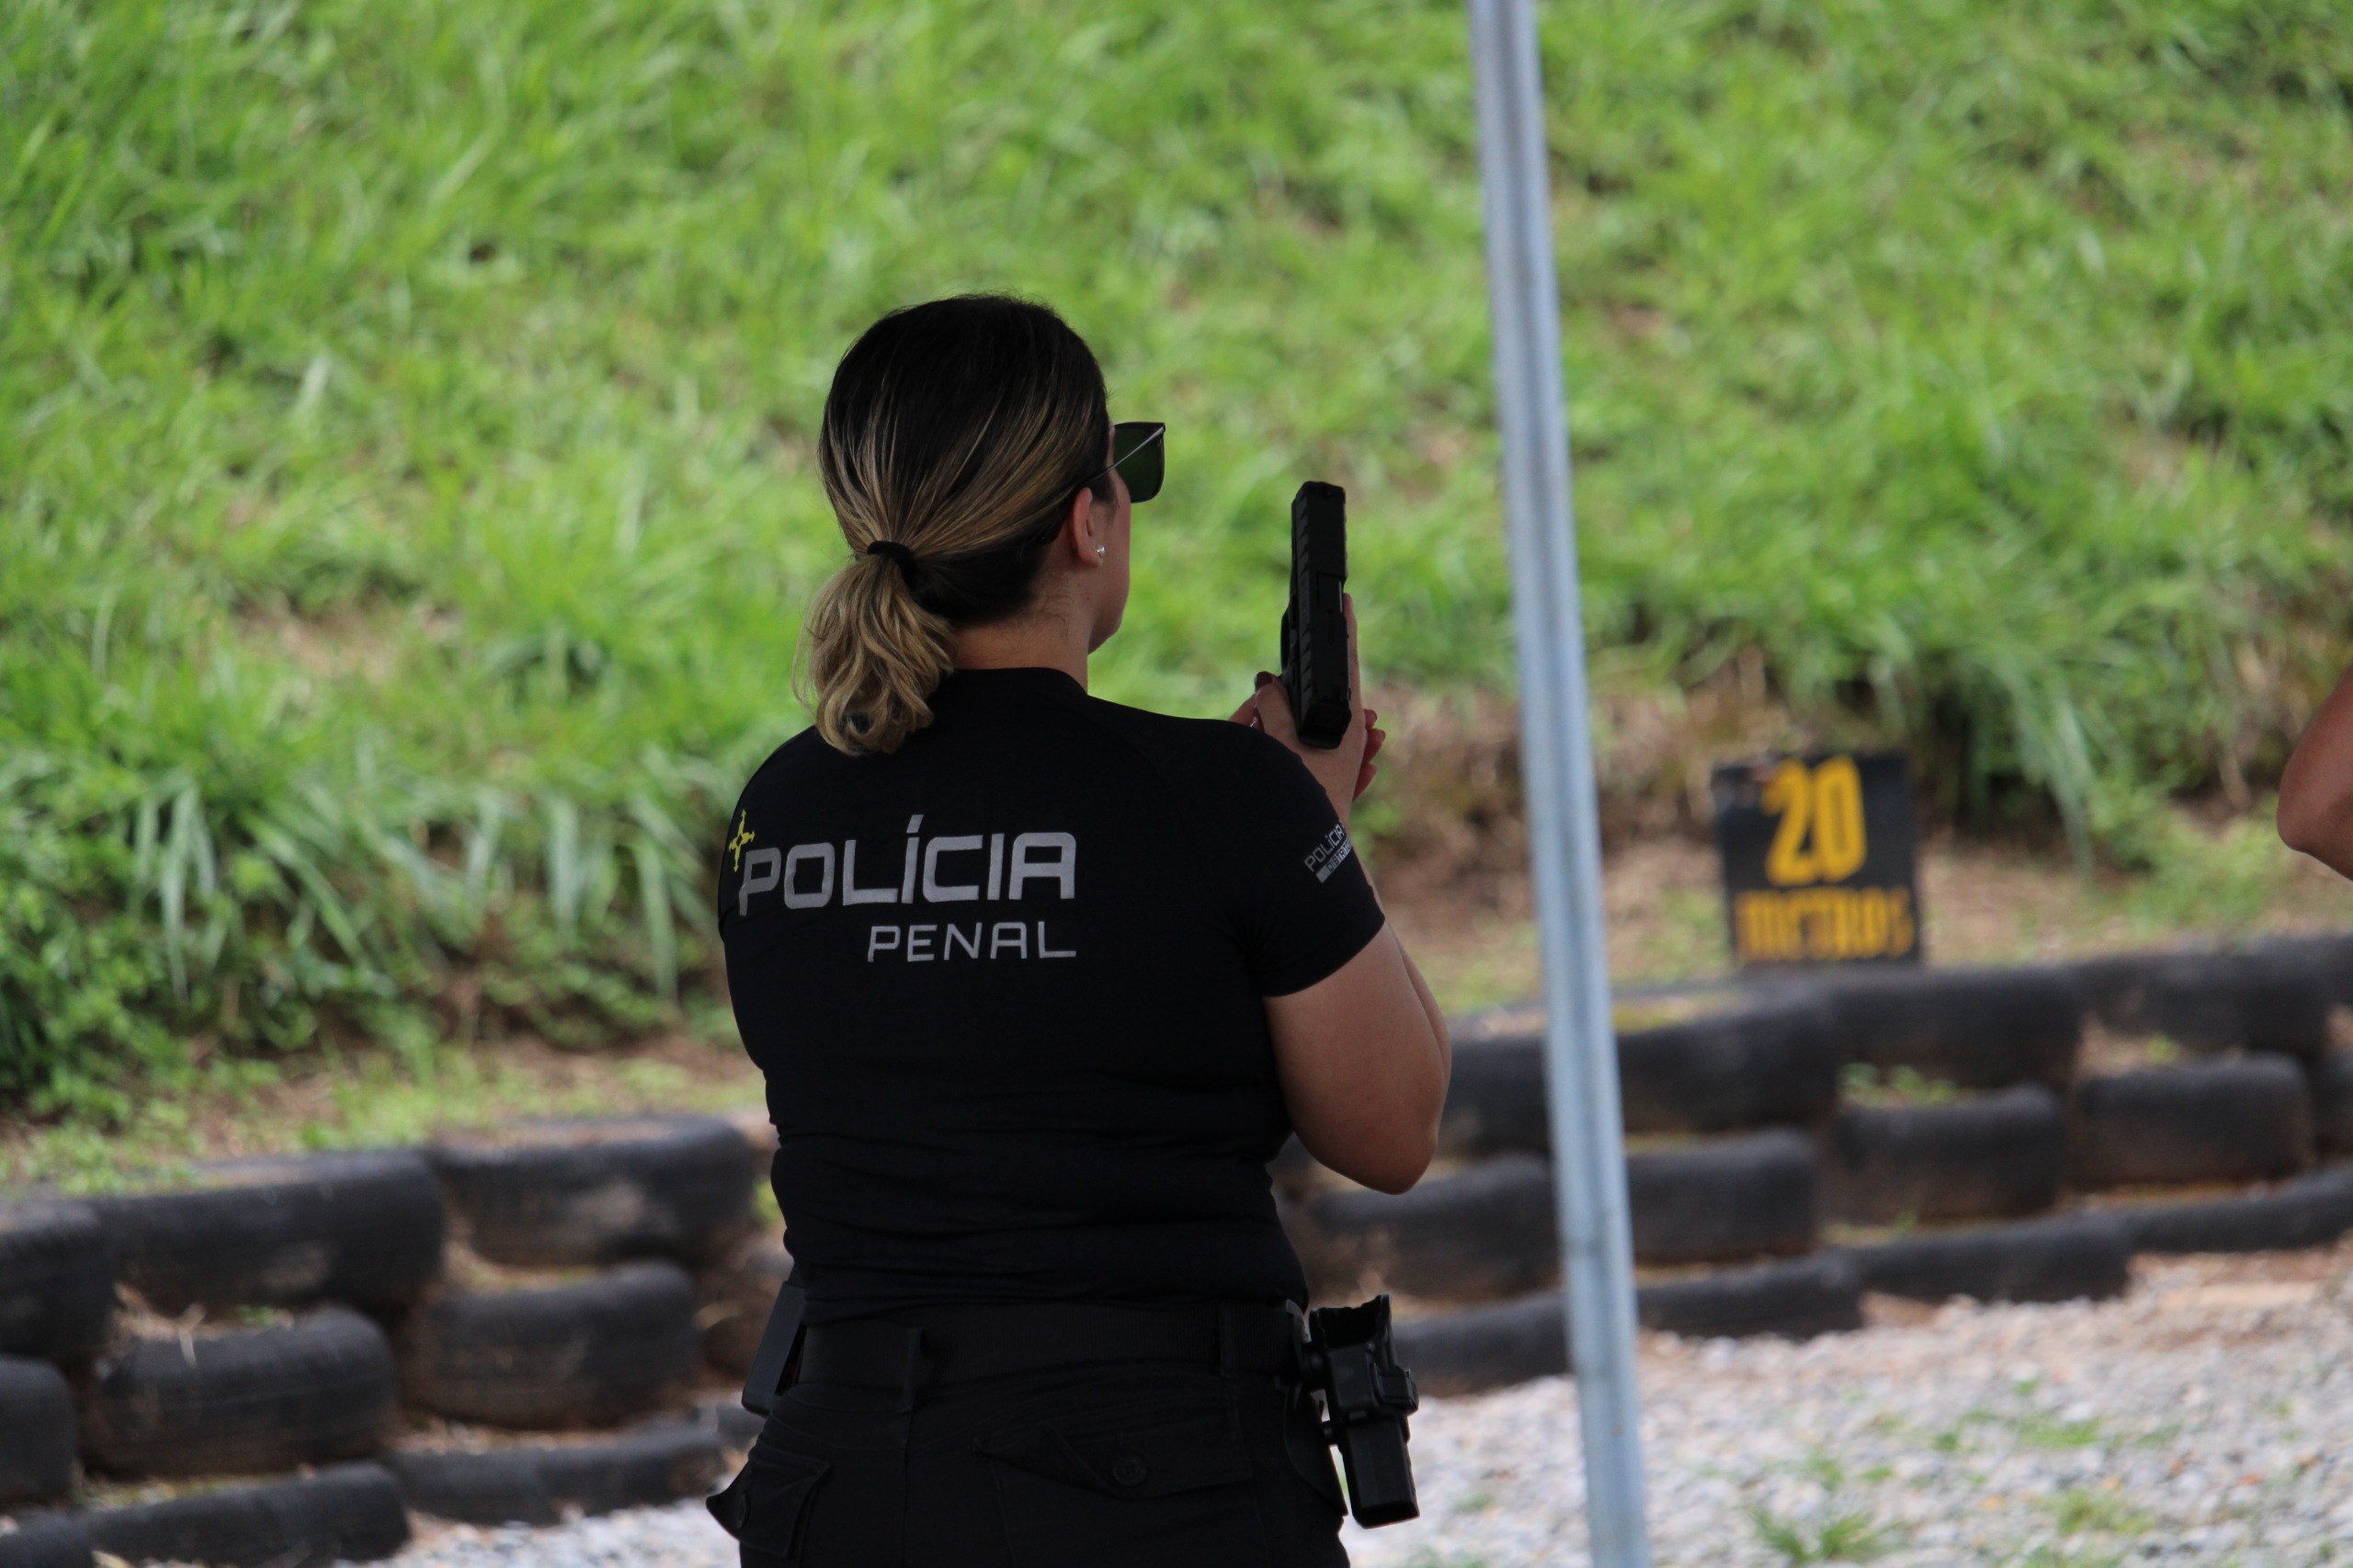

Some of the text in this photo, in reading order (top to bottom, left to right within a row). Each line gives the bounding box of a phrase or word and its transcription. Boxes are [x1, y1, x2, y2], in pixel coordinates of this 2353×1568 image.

[739, 814, 1076, 916] POLÍCIA
[1764, 757, 1866, 885] 20
[868, 921, 1076, 962] PENAL
